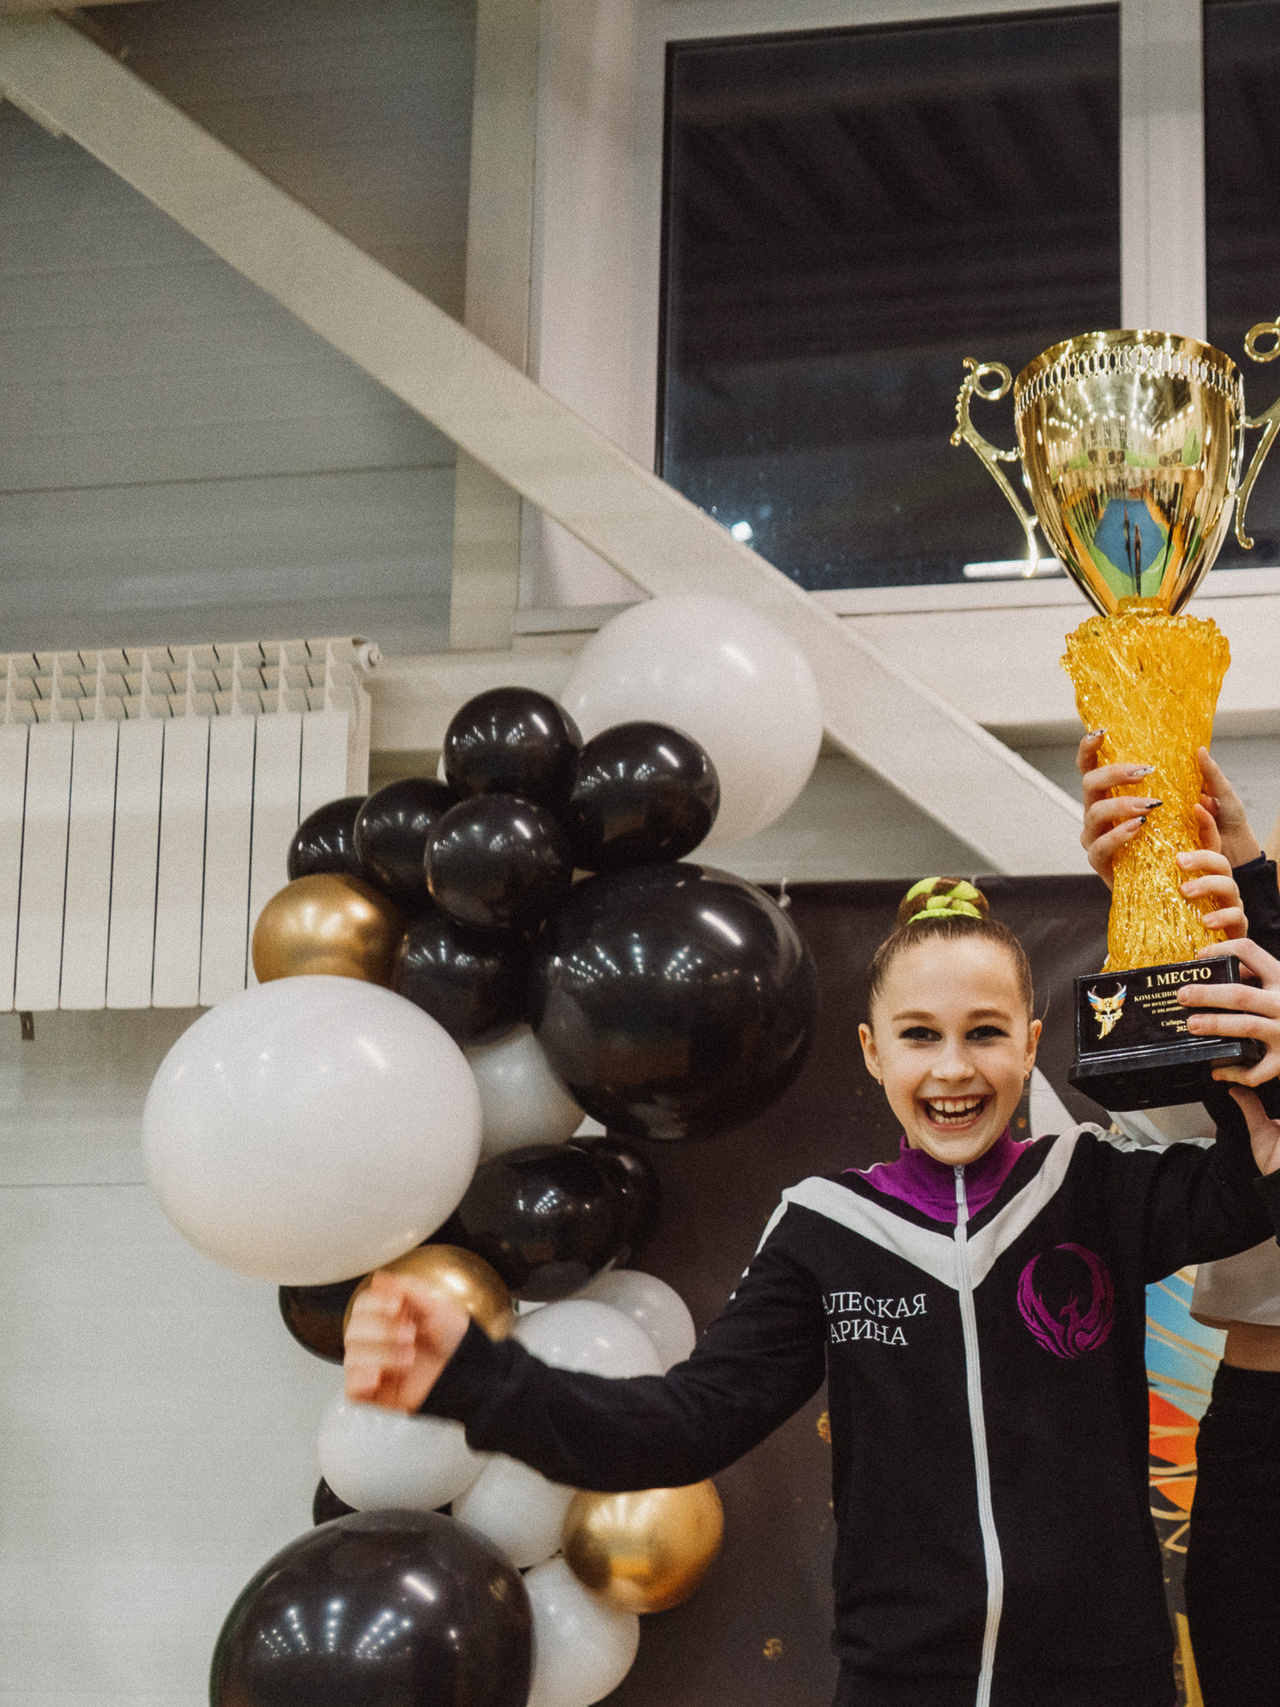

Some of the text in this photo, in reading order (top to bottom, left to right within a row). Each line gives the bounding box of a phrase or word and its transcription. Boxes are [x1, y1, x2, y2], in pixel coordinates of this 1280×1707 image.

[1146, 966, 1212, 988] 1 МЕСТО
[830, 1319, 908, 1346] АРИНА
